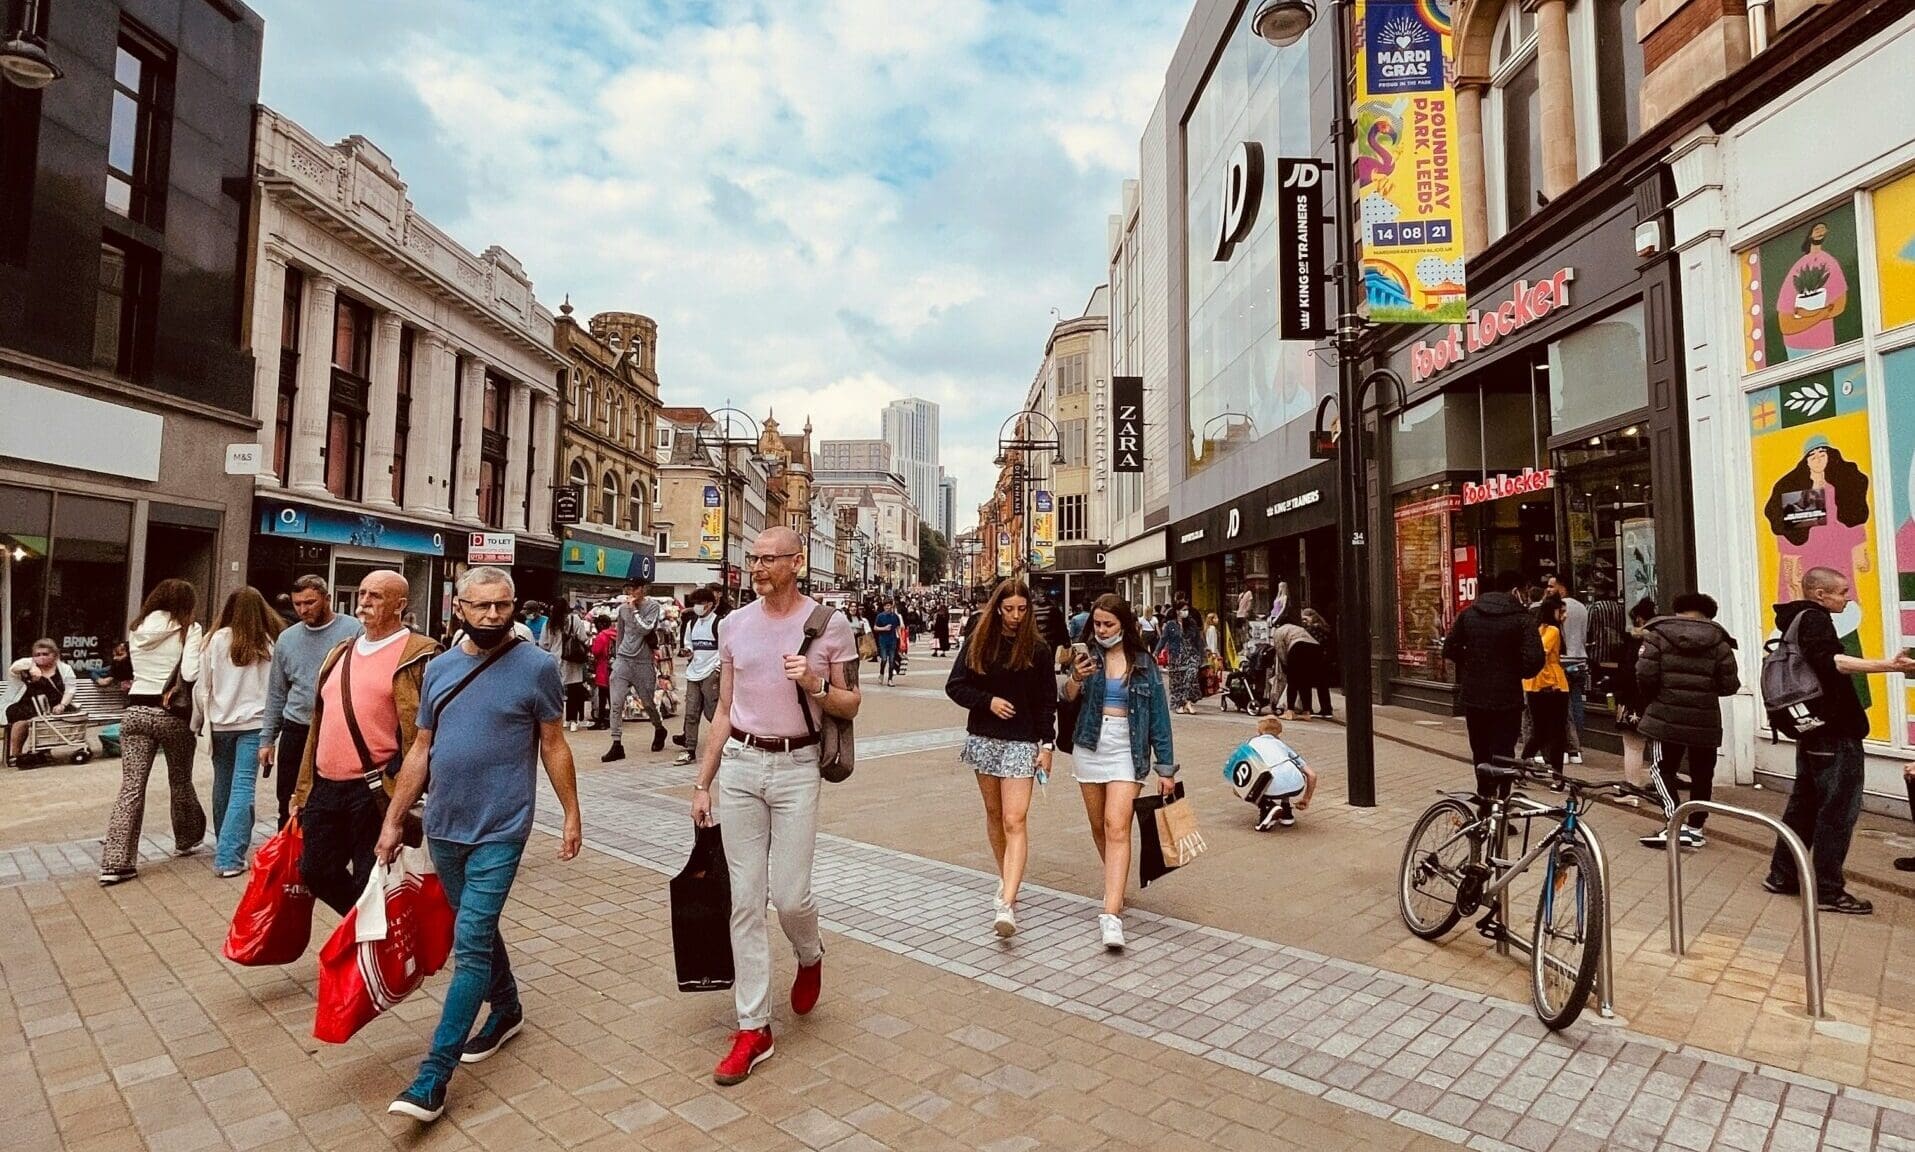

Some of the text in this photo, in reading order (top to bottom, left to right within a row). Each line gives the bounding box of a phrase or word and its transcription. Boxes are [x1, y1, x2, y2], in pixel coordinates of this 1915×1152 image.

[1378, 50, 1431, 64] MARDI
[1382, 63, 1428, 77] GRAS
[1431, 100, 1451, 208] ROUNDHAY
[1284, 163, 1320, 188] JD
[1416, 159, 1434, 214] LEEDS
[1377, 226, 1446, 240] 14 08 21
[1298, 195, 1310, 307] KING OF TRAINERS
[1411, 267, 1574, 384] Foot Locker
[1118, 405, 1139, 467] ZARA
[1463, 468, 1554, 506] Foot Locker
[1227, 508, 1240, 539] JD
[1458, 577, 1477, 602] 50
[63, 636, 98, 648] BRING
[73, 650, 87, 658] ON
[1236, 763, 1249, 786] JD
